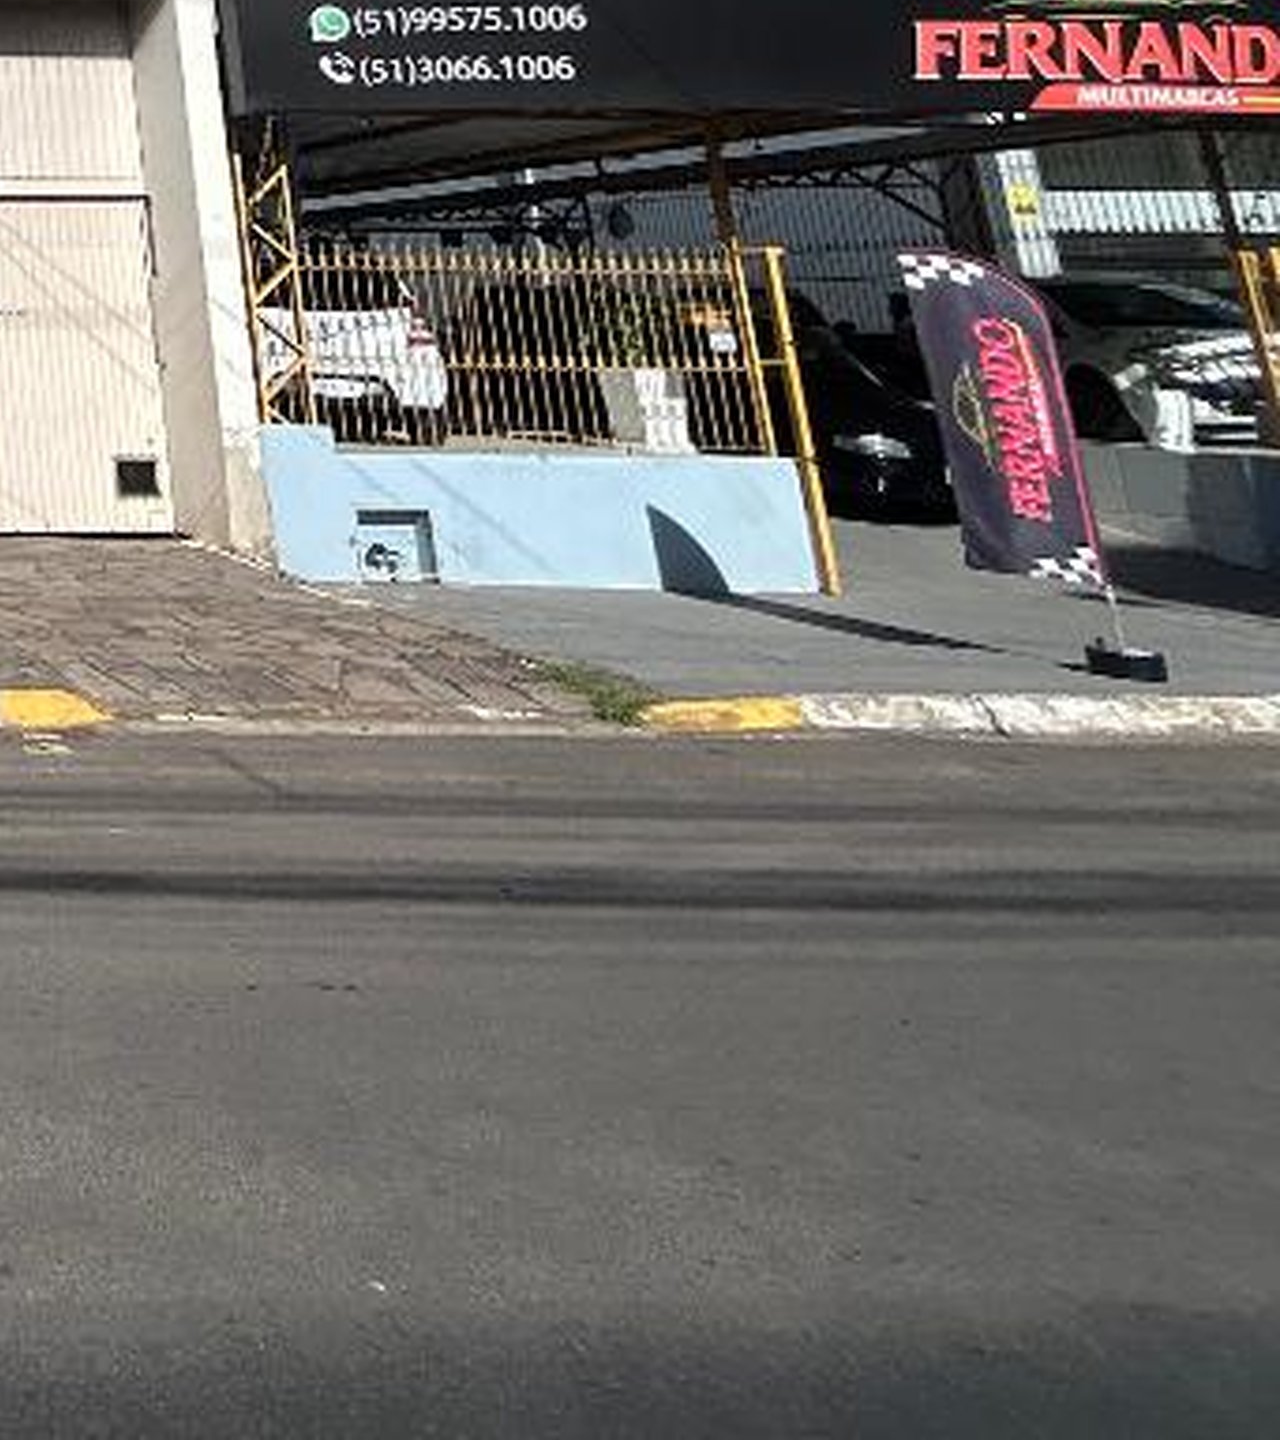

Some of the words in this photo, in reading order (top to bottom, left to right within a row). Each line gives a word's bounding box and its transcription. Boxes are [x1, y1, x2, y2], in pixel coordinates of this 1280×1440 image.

[353, 4, 588, 38] (51)99575.1006
[359, 53, 576, 87] (51)3066.1006
[1075, 86, 1240, 107] MULTIMARCAS
[971, 317, 1053, 522] FERNANDO
